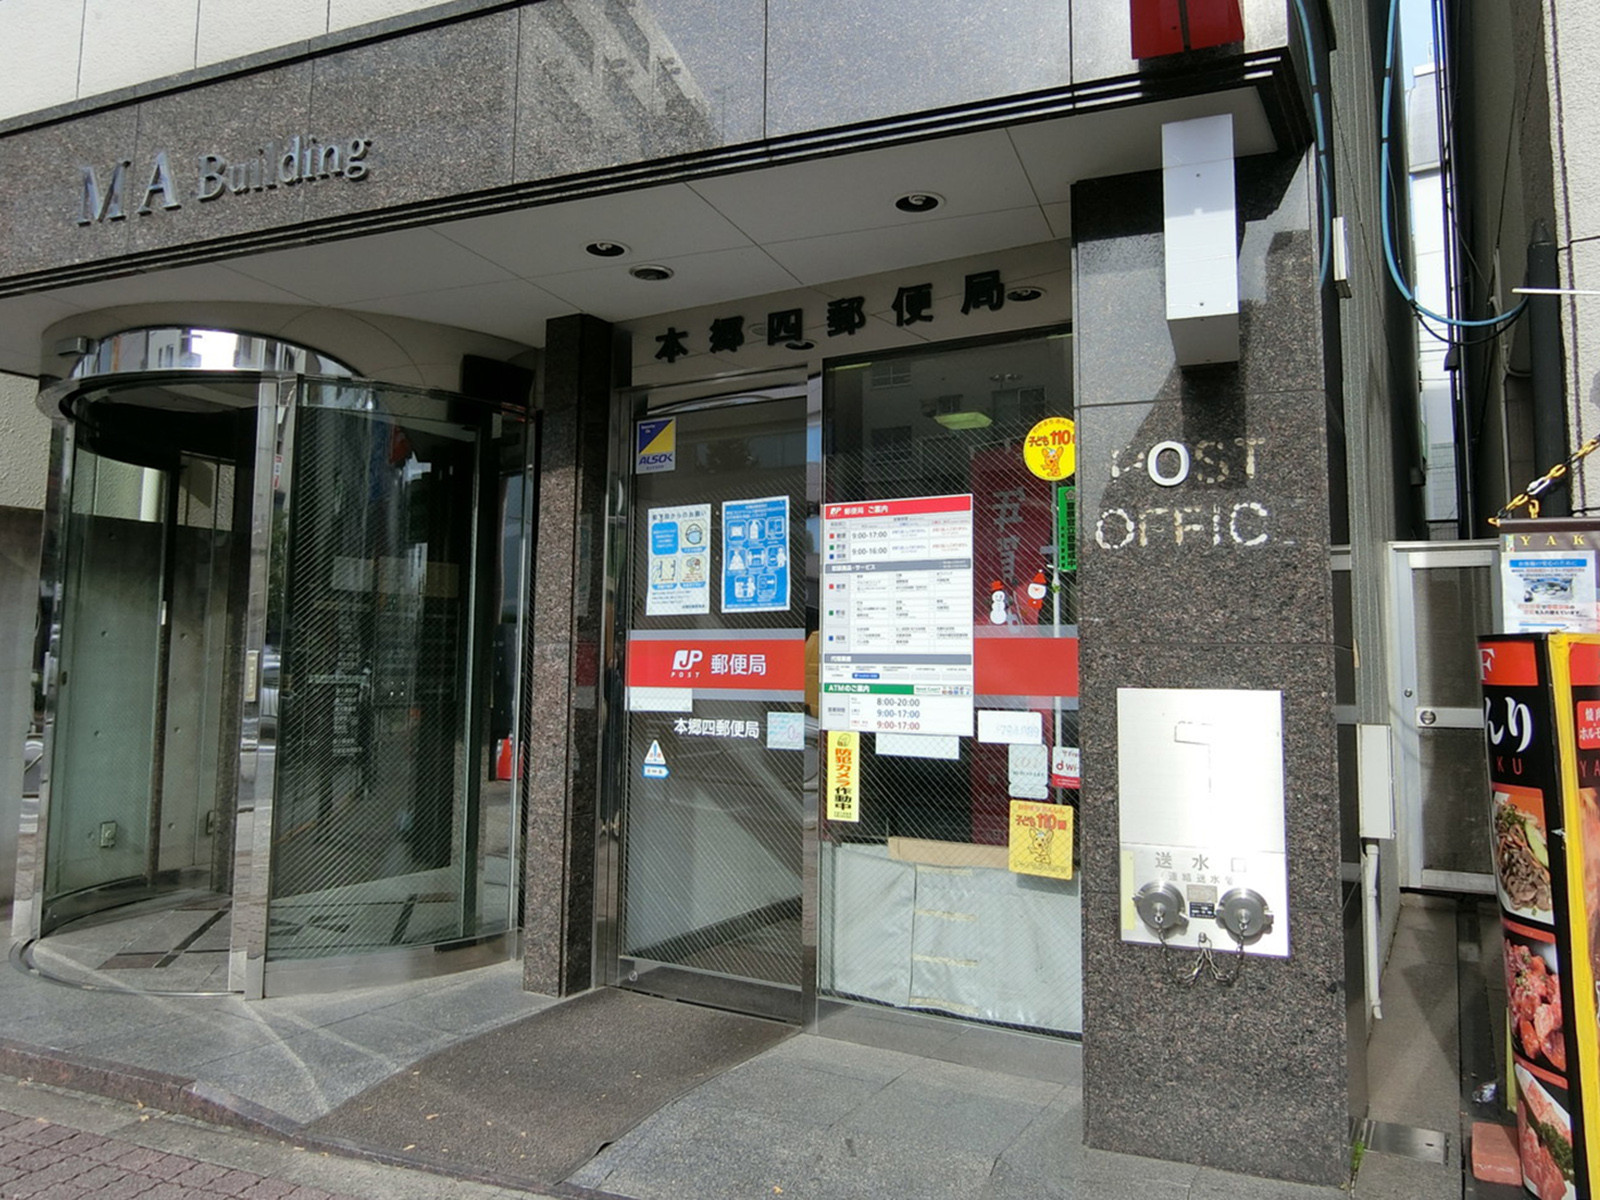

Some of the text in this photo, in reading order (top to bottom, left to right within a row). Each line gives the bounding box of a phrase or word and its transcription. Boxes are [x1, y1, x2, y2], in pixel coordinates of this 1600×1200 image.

[198, 133, 371, 202] Building
[654, 270, 1005, 363] 本郷四郵便局
[1028, 430, 1076, 448] 子ども110
[638, 453, 673, 466] ALSOK
[1095, 501, 1295, 550] OFFIC
[711, 654, 766, 676] 郵便局
[828, 684, 870, 693] ATMのご案内
[877, 697, 920, 707] 8:00-20:00
[877, 709, 920, 719] 9:00-17:00
[674, 717, 760, 739] 本郷四郵便局
[877, 720, 920, 730] 9:00-17:00
[1155, 851, 1247, 873] 送水口
